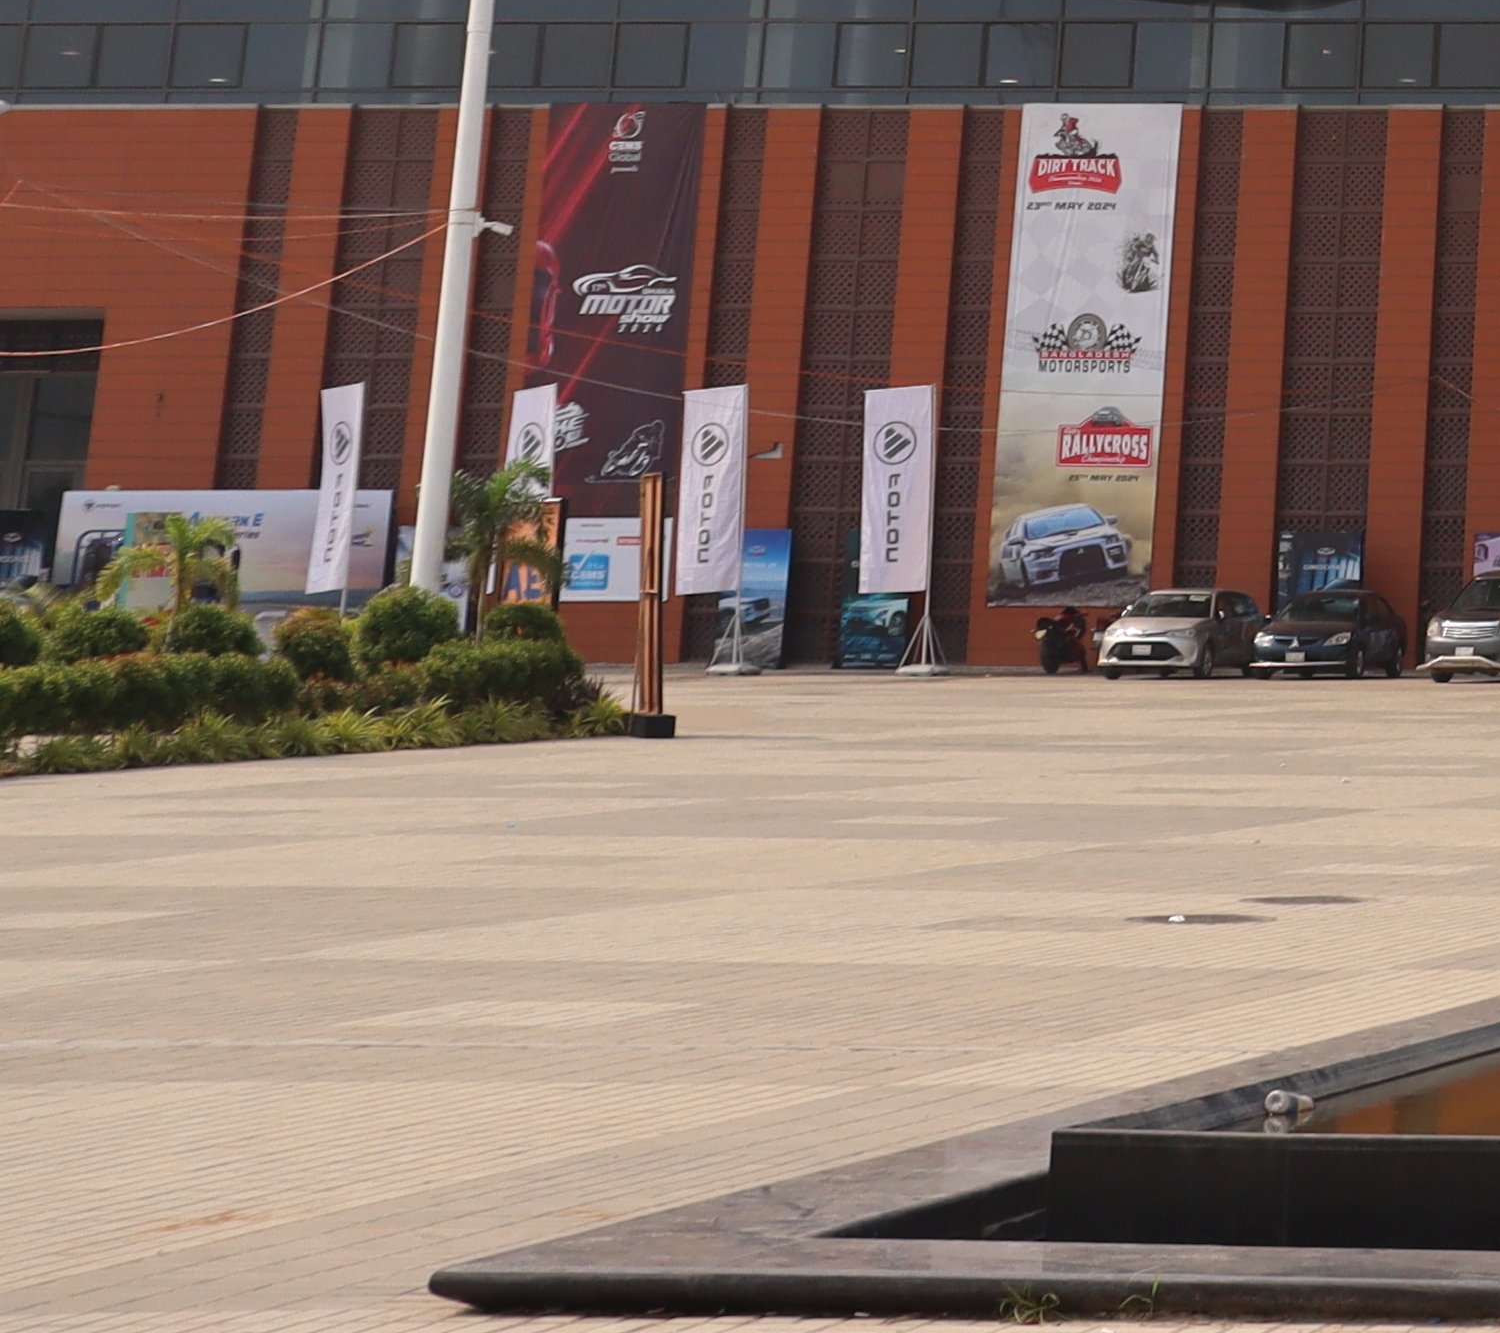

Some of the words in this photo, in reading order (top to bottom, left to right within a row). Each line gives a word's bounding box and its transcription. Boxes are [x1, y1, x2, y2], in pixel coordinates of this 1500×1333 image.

[608, 152, 641, 162] Global
[1037, 159, 1067, 176] DIRT
[1071, 159, 1116, 177] TRACK
[1054, 202, 1084, 210] MAY
[1087, 202, 1116, 210] 2024
[579, 295, 676, 314] MOTOR
[1040, 351, 1130, 359] BANGLADESH
[1038, 360, 1130, 373] MOTORSPORTS
[1061, 434, 1148, 460] RALLYCROSS
[696, 474, 715, 563] FOTON
[885, 473, 902, 563] FOTON
